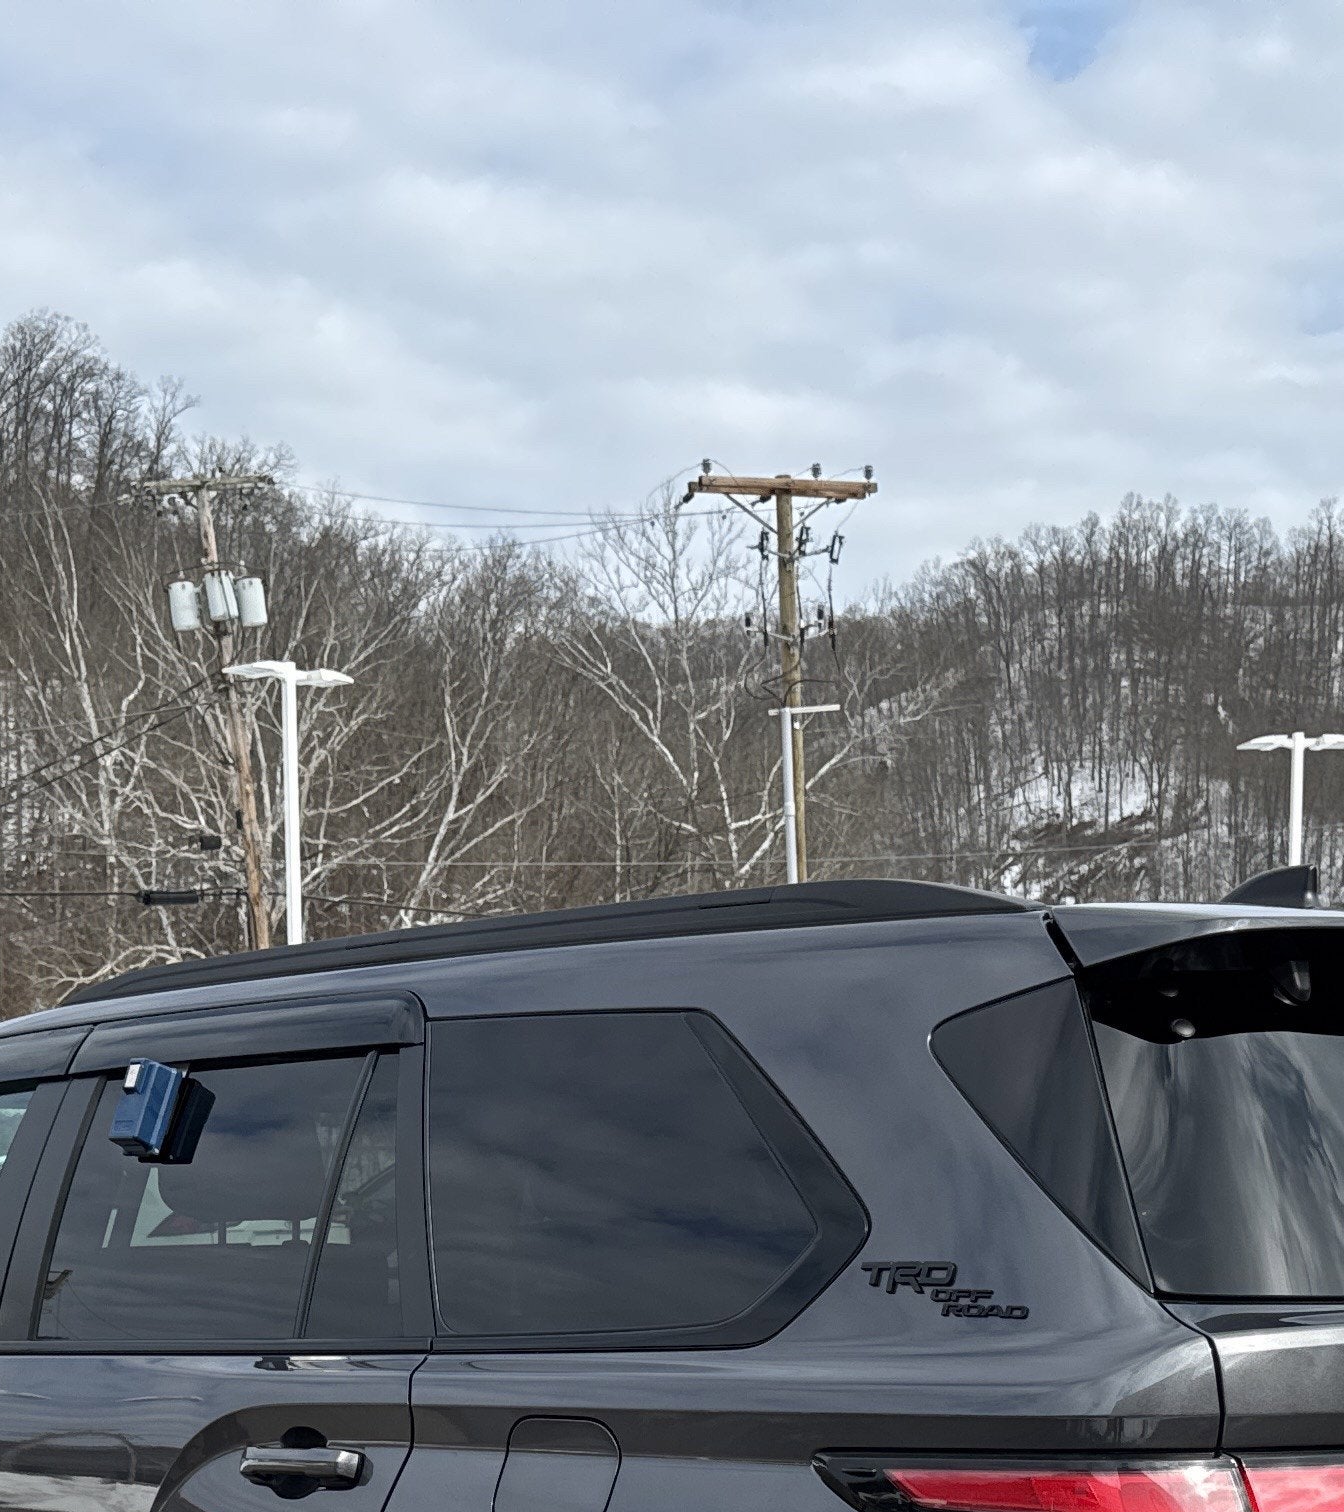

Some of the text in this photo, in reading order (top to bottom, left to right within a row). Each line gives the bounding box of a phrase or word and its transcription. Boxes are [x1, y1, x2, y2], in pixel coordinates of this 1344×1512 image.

[861, 1261, 958, 1294] TRD
[930, 1288, 994, 1303] OFF
[941, 1303, 1030, 1320] ROAD
